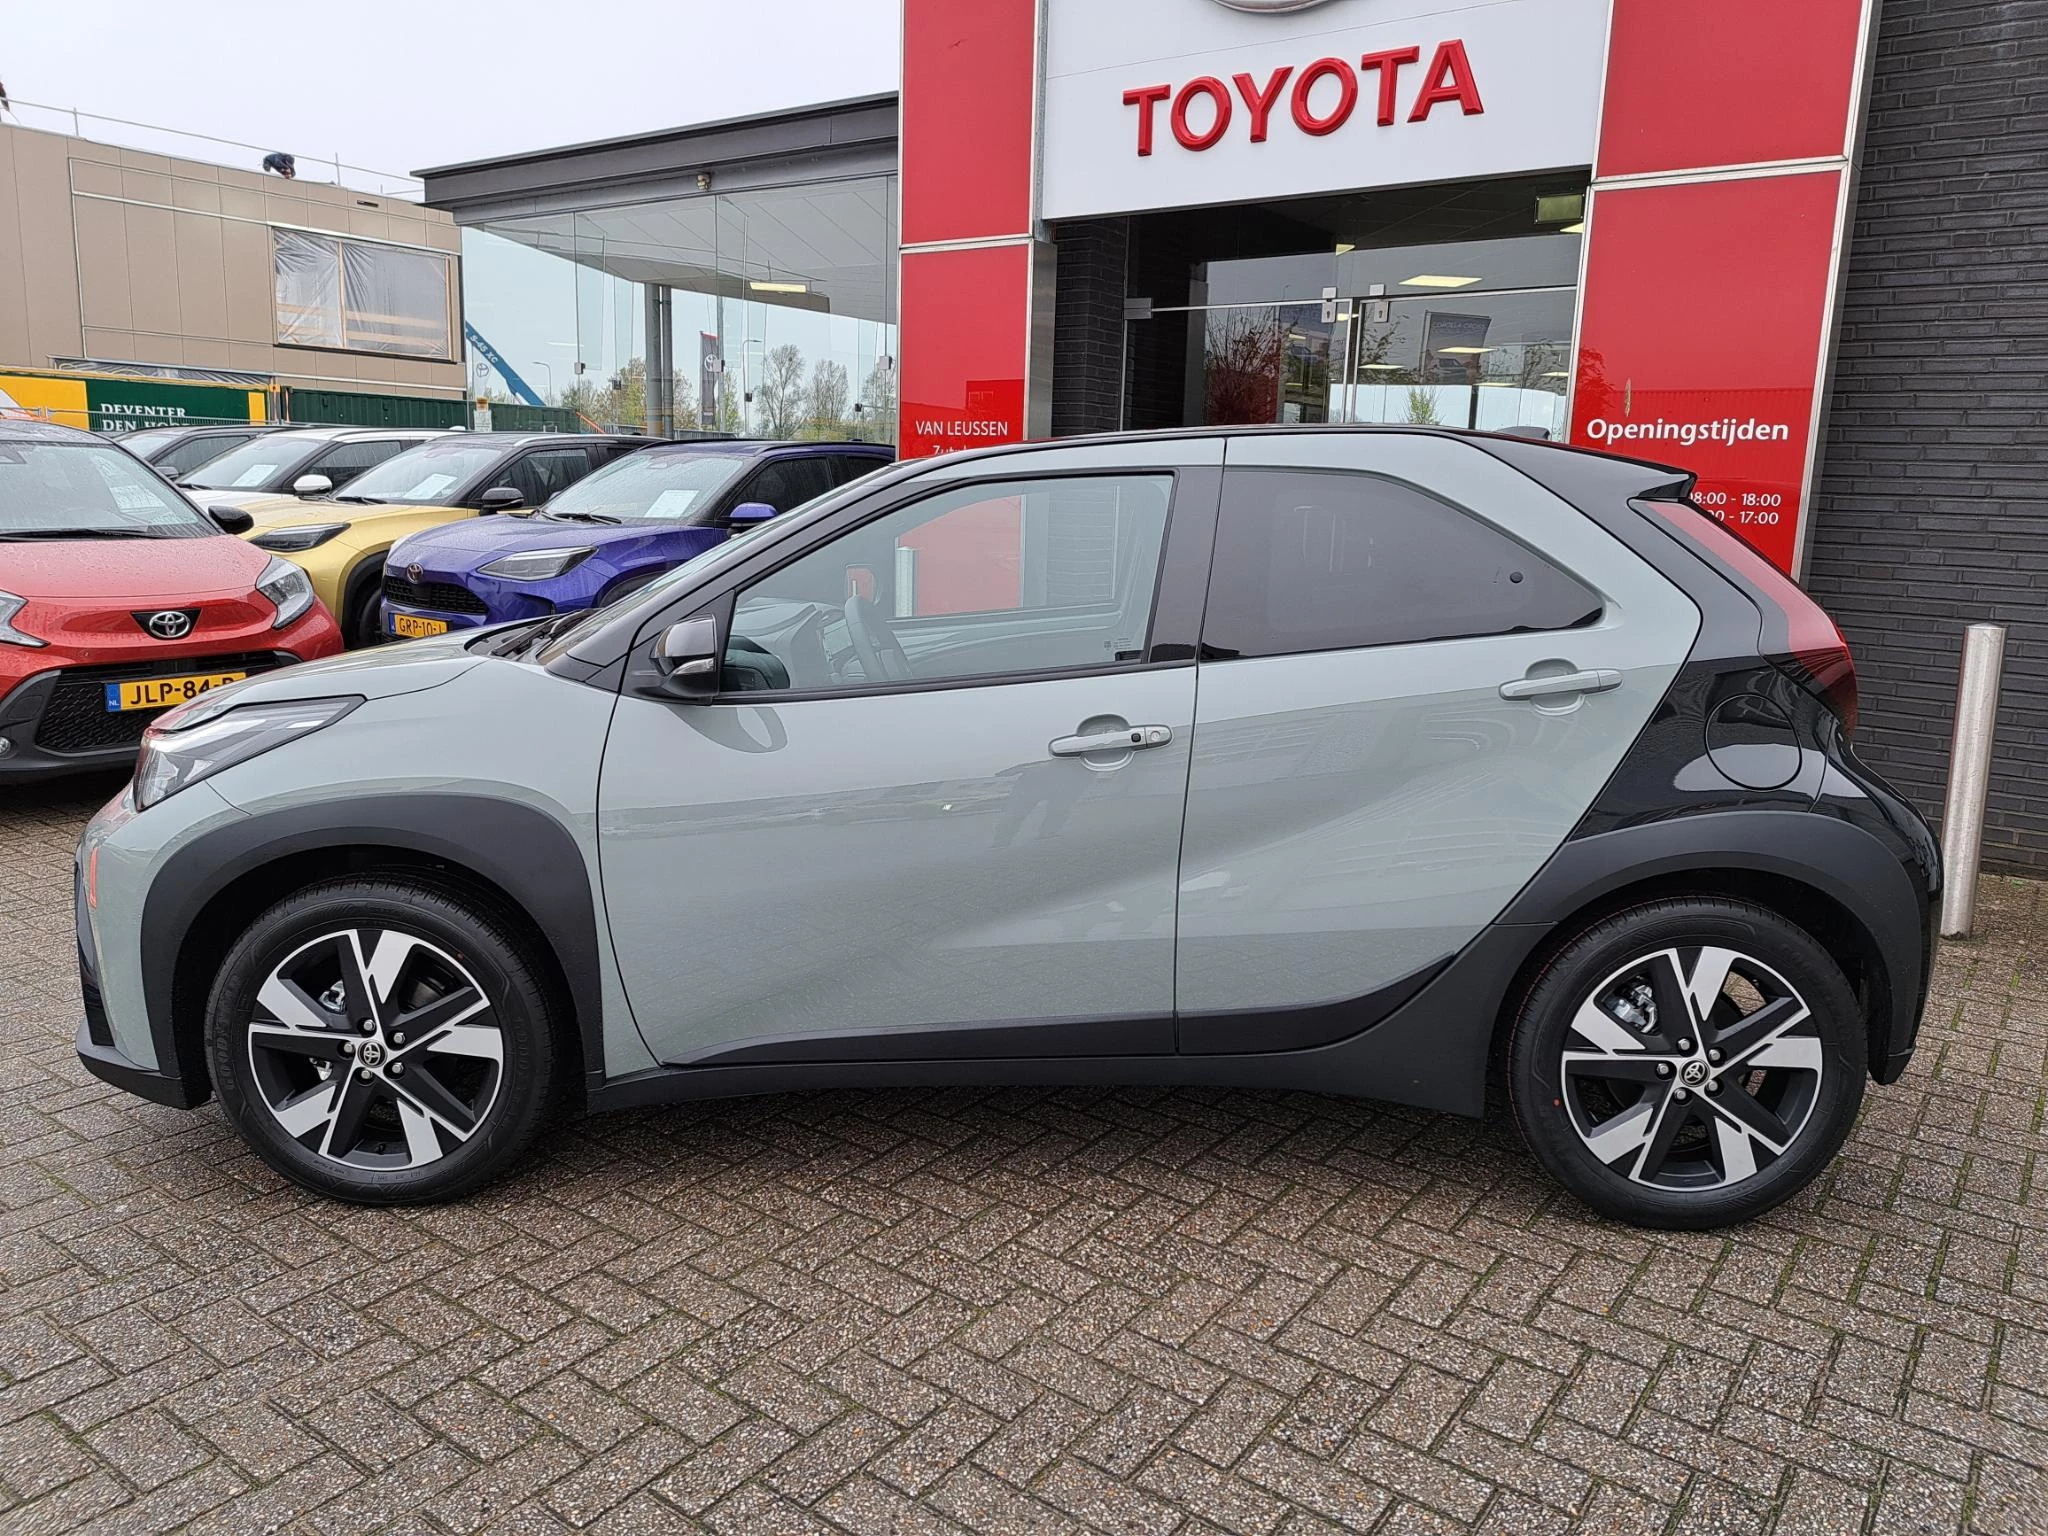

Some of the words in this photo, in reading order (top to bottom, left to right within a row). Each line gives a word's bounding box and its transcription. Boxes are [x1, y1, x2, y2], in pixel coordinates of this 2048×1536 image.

[1122, 38, 1484, 157] TOYOTA
[100, 403, 186, 417] DEVENTER
[102, 419, 136, 432] DEN
[915, 421, 943, 436] VAN
[947, 421, 1008, 436] LEUSSEN
[1587, 418, 1789, 446] Openingstijden
[1741, 493, 1781, 507] 18:00
[1739, 511, 1779, 525] 17:00
